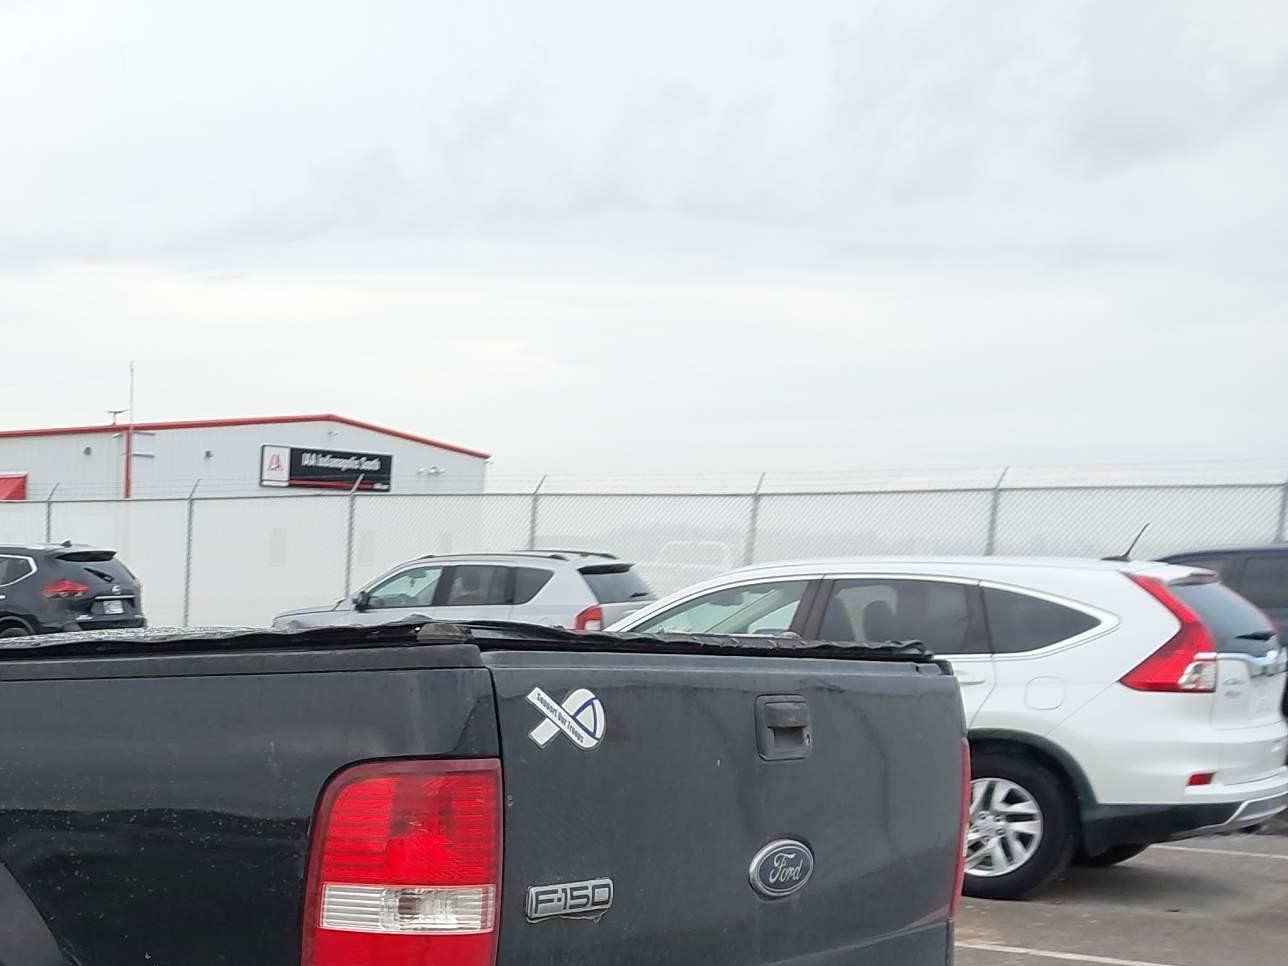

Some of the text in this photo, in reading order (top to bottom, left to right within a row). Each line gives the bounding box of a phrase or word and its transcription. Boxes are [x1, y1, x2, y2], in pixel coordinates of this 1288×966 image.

[535, 693, 558, 718] Support
[566, 720, 585, 744] Troops
[769, 852, 804, 884] Ford
